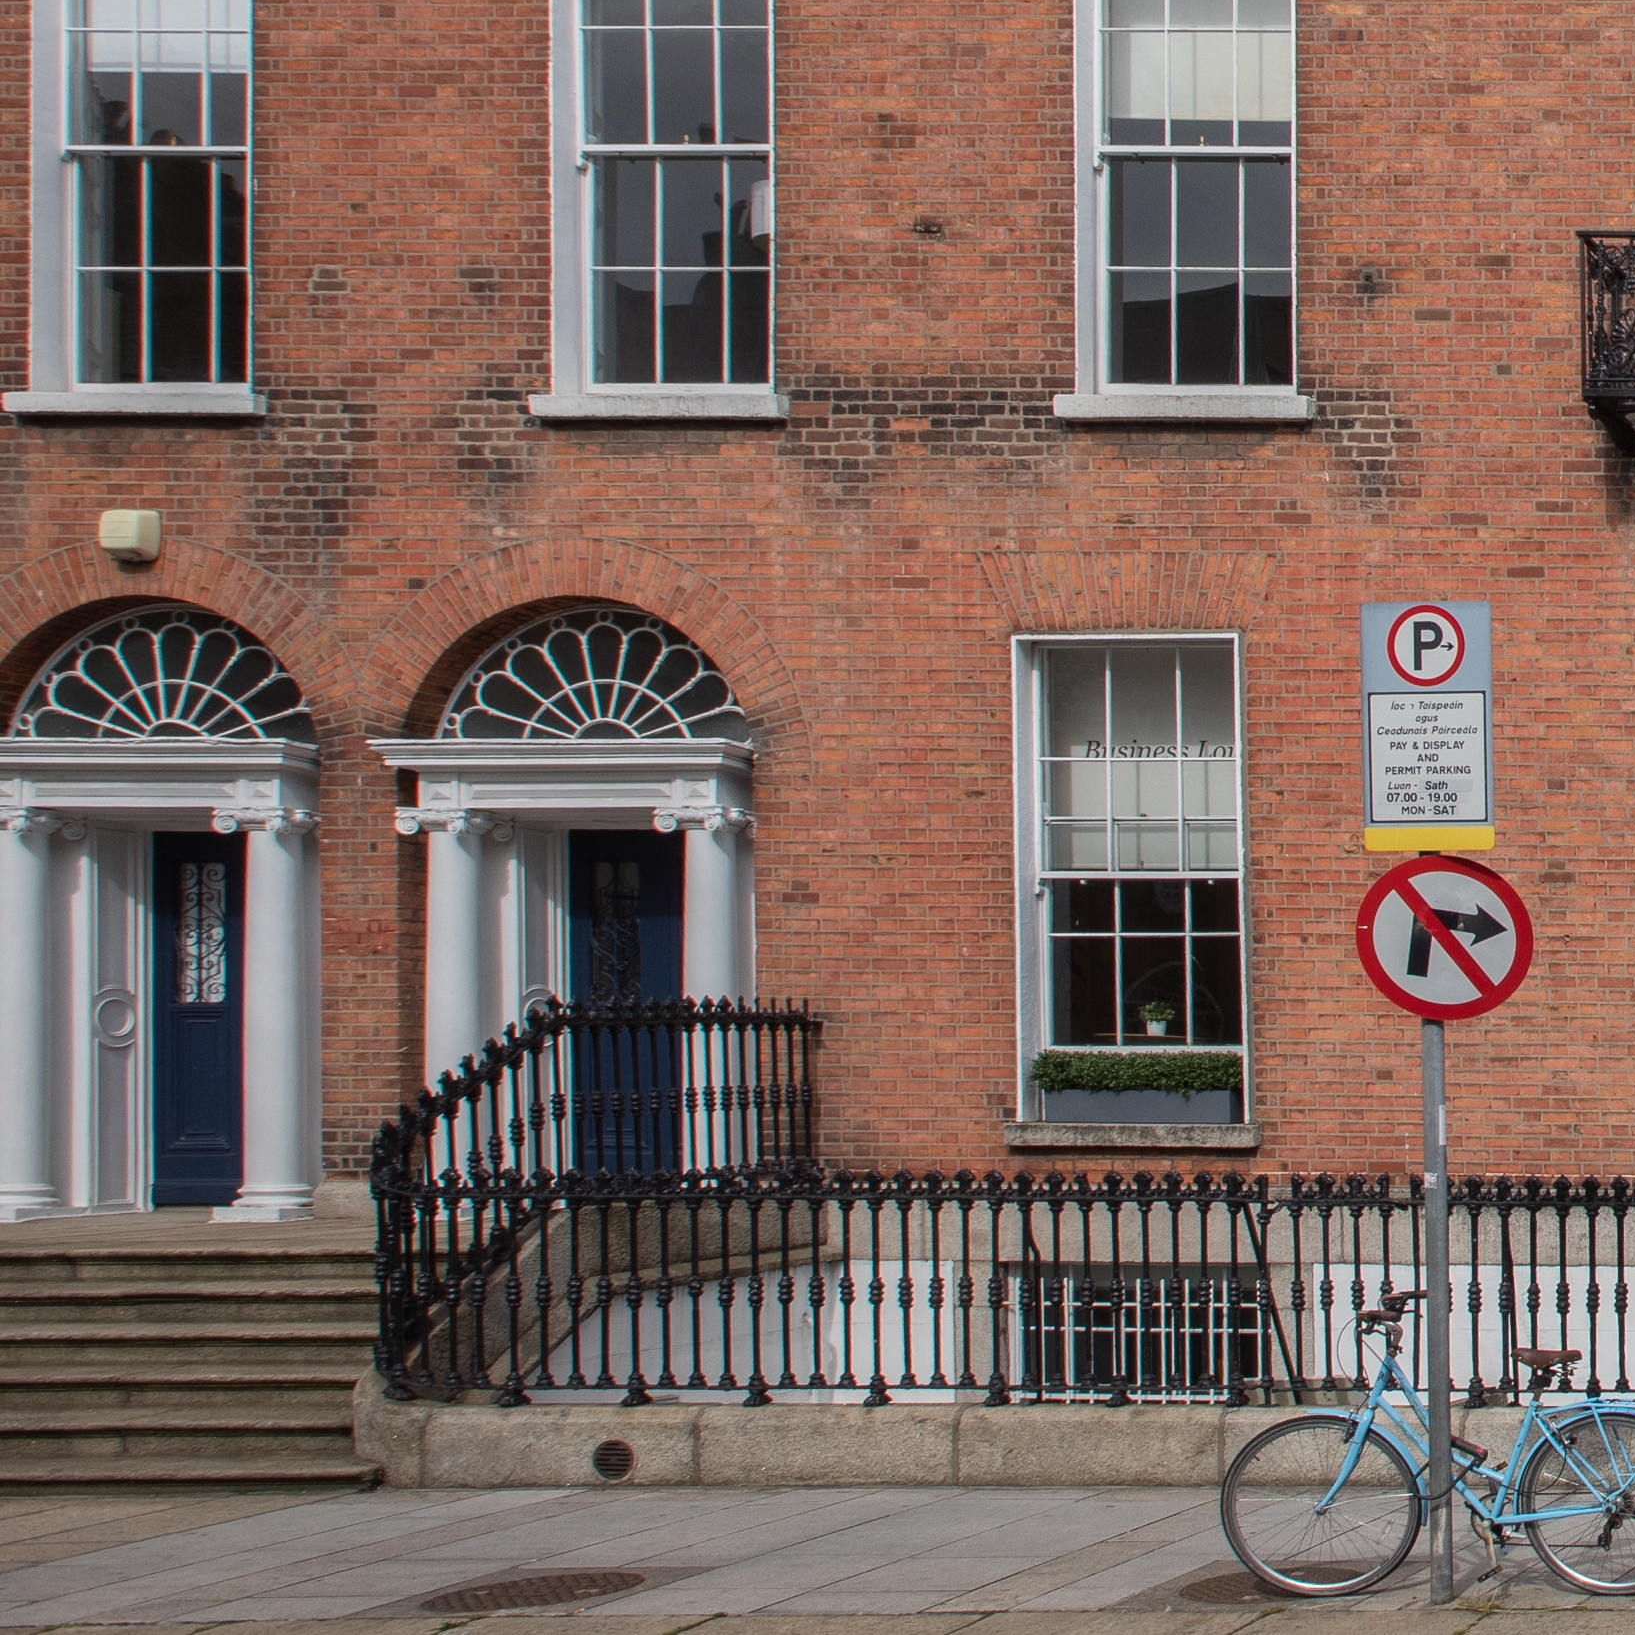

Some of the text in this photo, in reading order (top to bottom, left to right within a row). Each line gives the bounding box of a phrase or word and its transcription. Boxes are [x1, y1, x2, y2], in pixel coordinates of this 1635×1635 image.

[1413, 621, 1443, 671] P
[1415, 715, 1439, 724] agus
[1086, 739, 1189, 758] Business
[1389, 741, 1465, 750] PAY & DISPLAY
[1417, 753, 1439, 762] AND
[1385, 765, 1471, 775] PERMIT PARKING
[1387, 781, 1411, 790] Luan
[1424, 781, 1448, 790] Sath
[1387, 793, 1418, 803] 07.00
[1428, 792, 1458, 802] 19.00
[1401, 806, 1425, 815] MON
